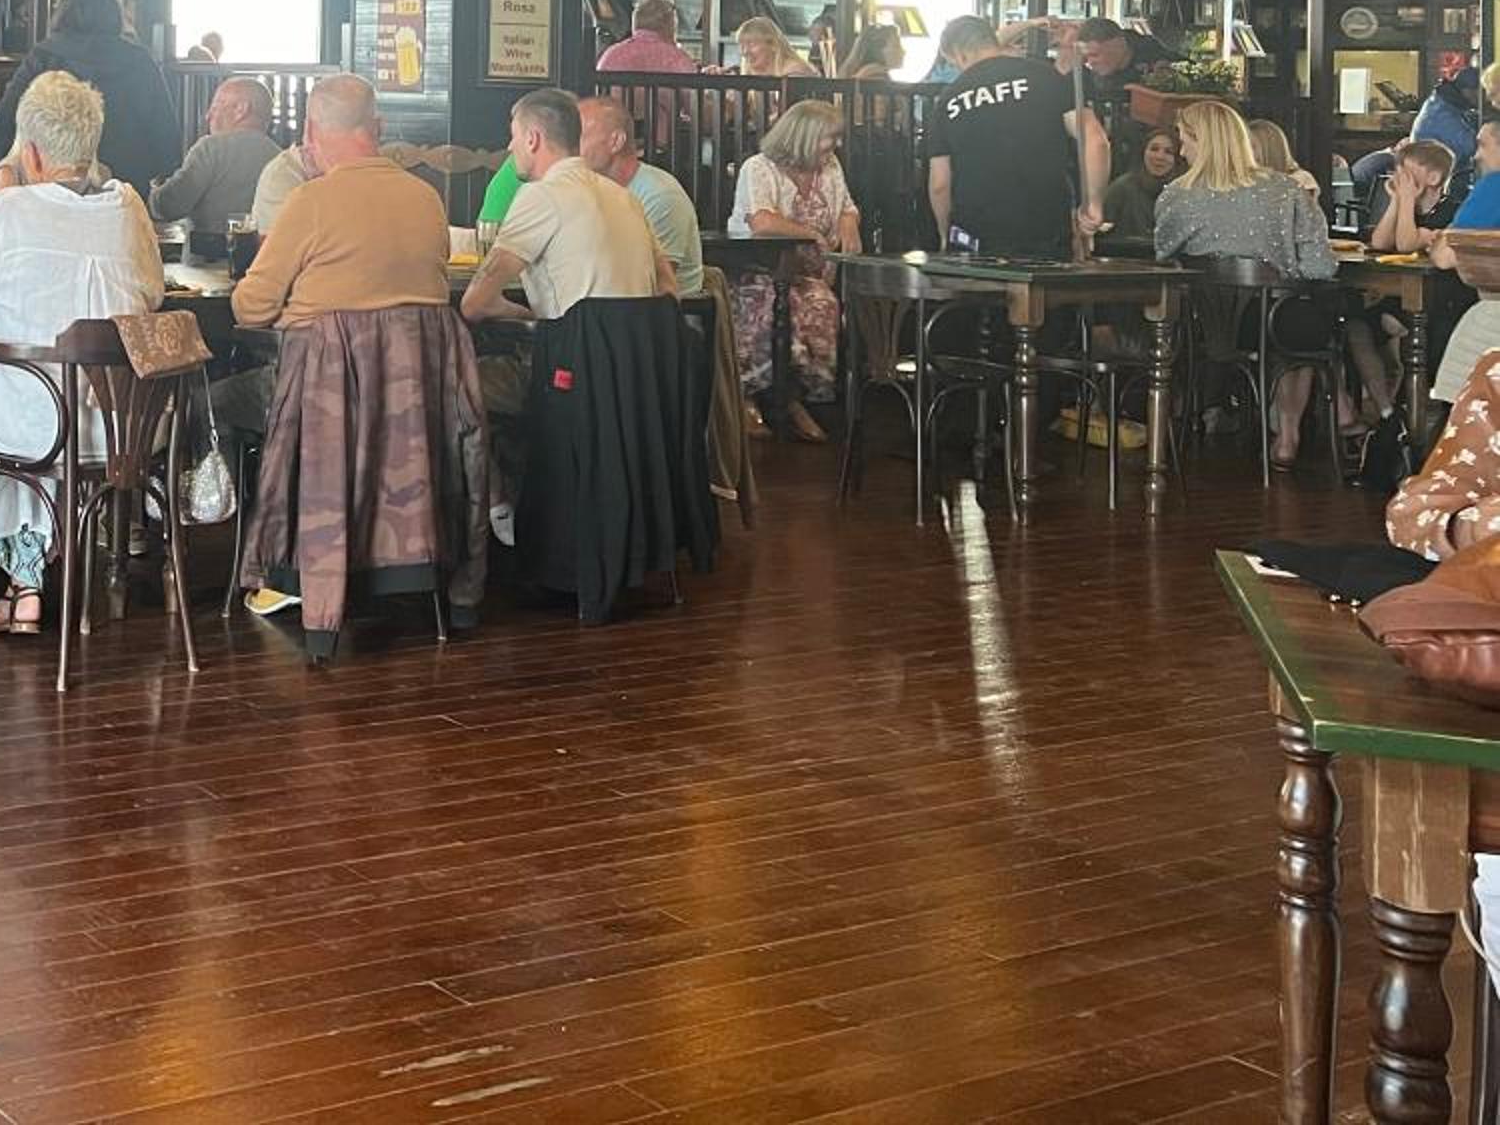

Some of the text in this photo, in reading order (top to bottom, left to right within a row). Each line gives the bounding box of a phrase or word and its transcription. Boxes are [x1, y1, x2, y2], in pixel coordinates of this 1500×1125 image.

[503, 0, 536, 13] Rosa
[505, 48, 532, 60] Wine
[947, 78, 1029, 120] STAFF
